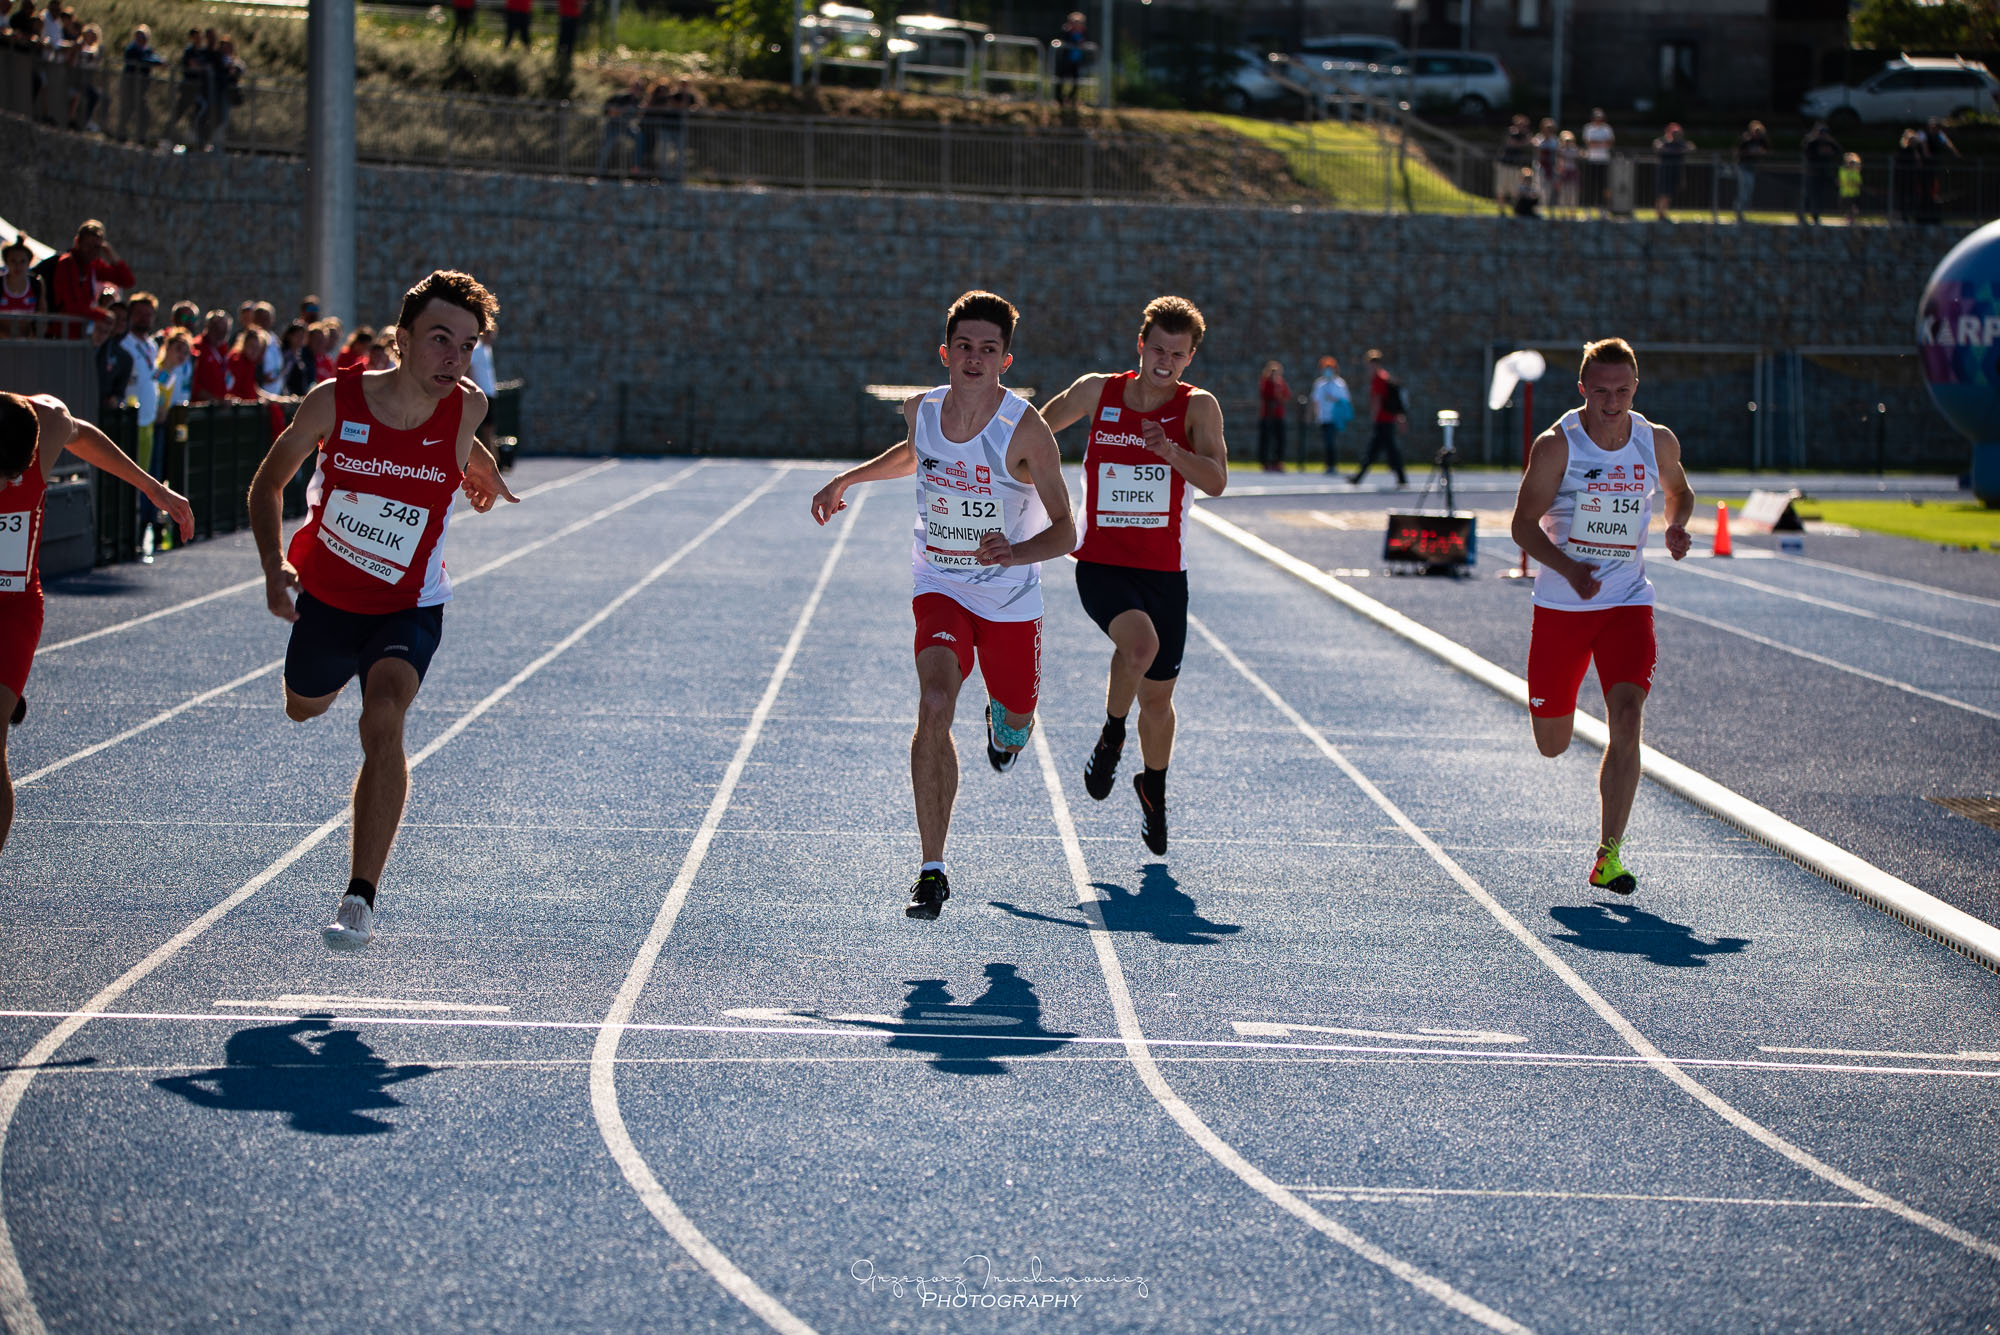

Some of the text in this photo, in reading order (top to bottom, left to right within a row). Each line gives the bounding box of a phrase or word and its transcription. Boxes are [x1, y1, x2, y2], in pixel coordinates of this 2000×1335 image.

[333, 452, 447, 483] CzechRepublic
[1133, 466, 1165, 481] 550
[925, 474, 992, 496] POLSKA
[1587, 482, 1644, 492] POLSKA
[1111, 490, 1154, 503] STIPEK
[379, 501, 421, 526] 548
[960, 501, 997, 518] 152
[1612, 498, 1640, 514] 154
[1105, 516, 1140, 525] KARPACZ
[1586, 521, 1628, 535] KRUPA
[335, 512, 405, 551] KUBELIK
[929, 521, 1002, 541] SZACHNIEW
[327, 537, 368, 567] KARPACZ
[368, 561, 392, 577] 2020
[934, 554, 972, 566] KARPACZ
[1576, 546, 1631, 558] KARPACZ 2020
